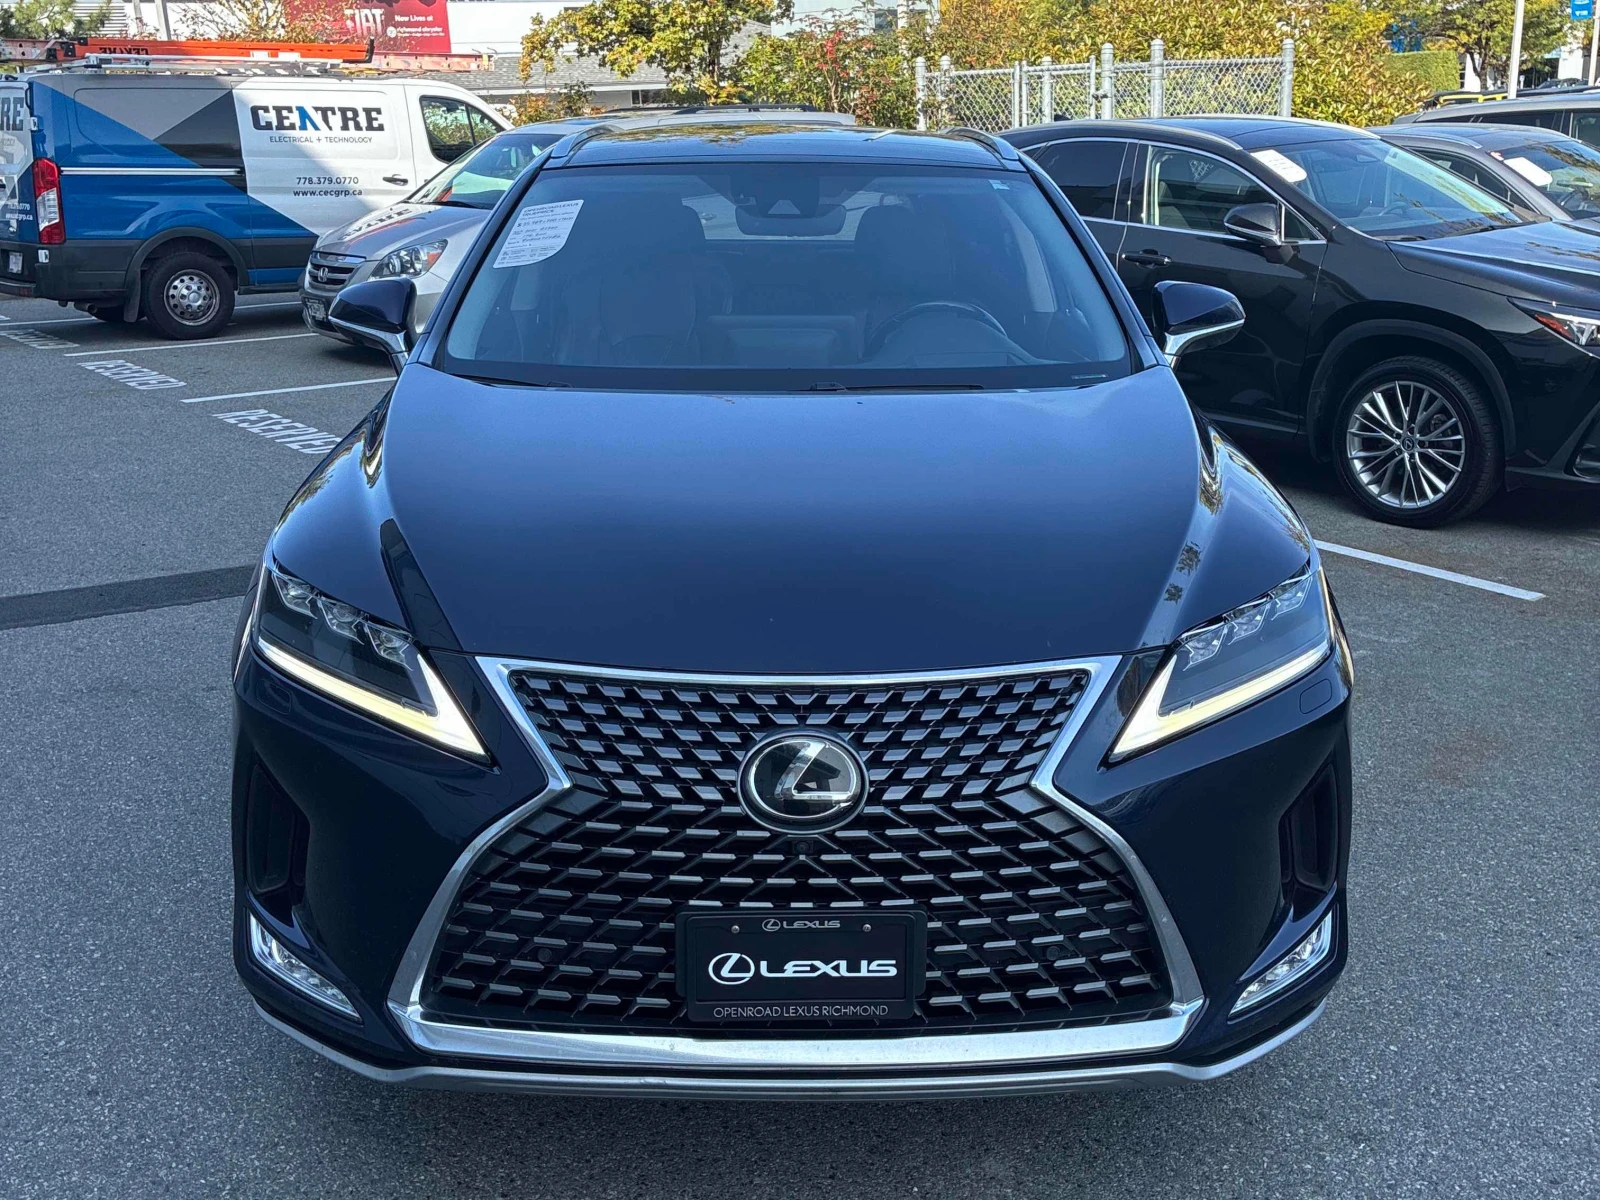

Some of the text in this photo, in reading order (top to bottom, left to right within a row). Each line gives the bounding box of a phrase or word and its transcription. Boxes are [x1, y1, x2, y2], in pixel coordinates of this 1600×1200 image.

[250, 105, 385, 131] CENTRE
[296, 176, 359, 185] 778.379.0770
[293, 189, 363, 198] www.cecgrp.ca
[77, 360, 187, 390] RESERVED
[783, 920, 841, 929] LEXUS
[760, 959, 898, 978] LEXUS
[713, 1005, 889, 1018] OPENROAD LEXUS RICHMOND
